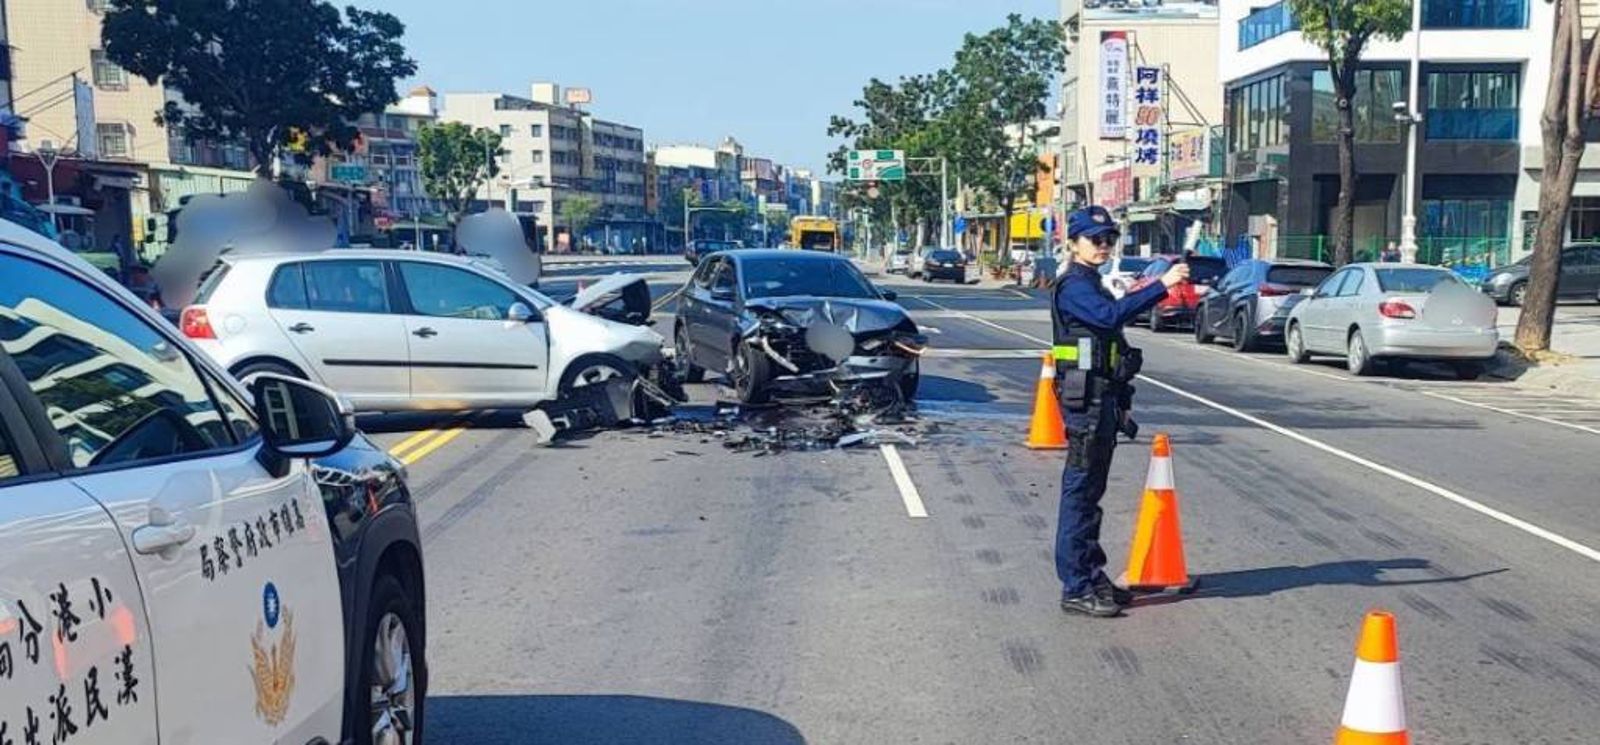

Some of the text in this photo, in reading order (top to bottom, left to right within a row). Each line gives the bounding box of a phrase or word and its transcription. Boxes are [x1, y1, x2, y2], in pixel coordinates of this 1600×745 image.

[200, 497, 305, 581] 高雄市政府警察局
